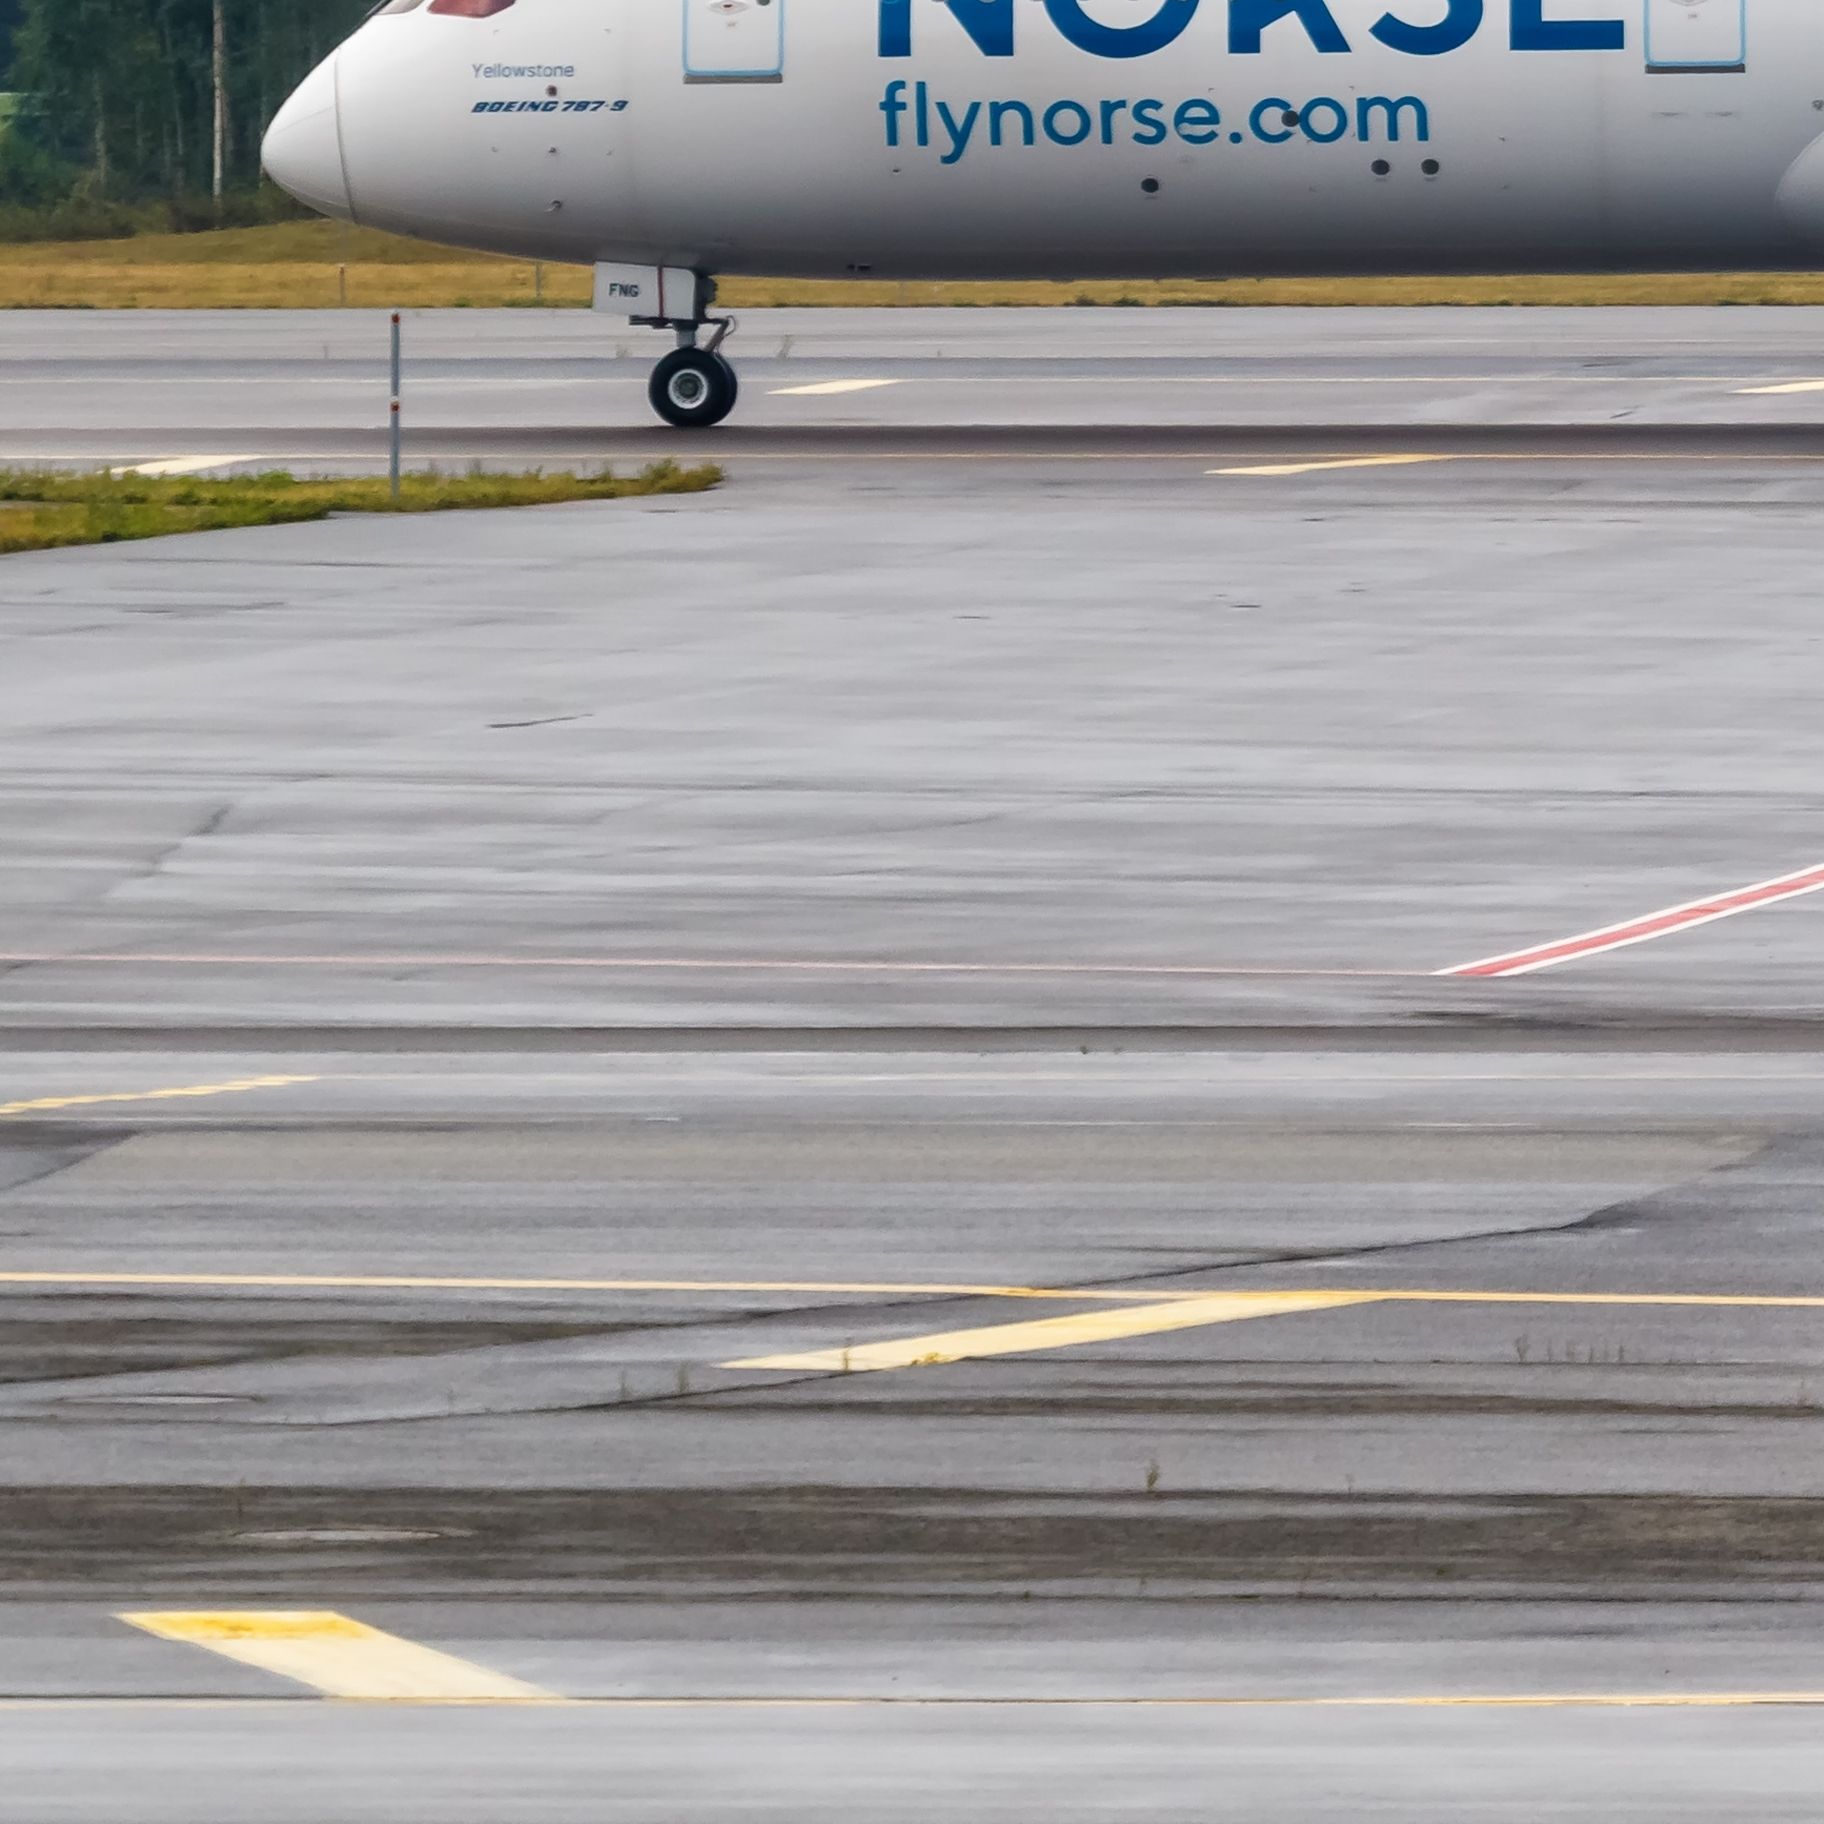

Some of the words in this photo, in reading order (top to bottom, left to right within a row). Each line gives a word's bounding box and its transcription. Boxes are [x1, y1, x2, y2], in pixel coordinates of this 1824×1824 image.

[471, 62, 575, 79] Yellowstone
[471, 99, 559, 114] BOEING
[561, 99, 630, 113] 787-9
[878, 79, 1430, 164] flynorse.com
[608, 282, 640, 298] FNG
